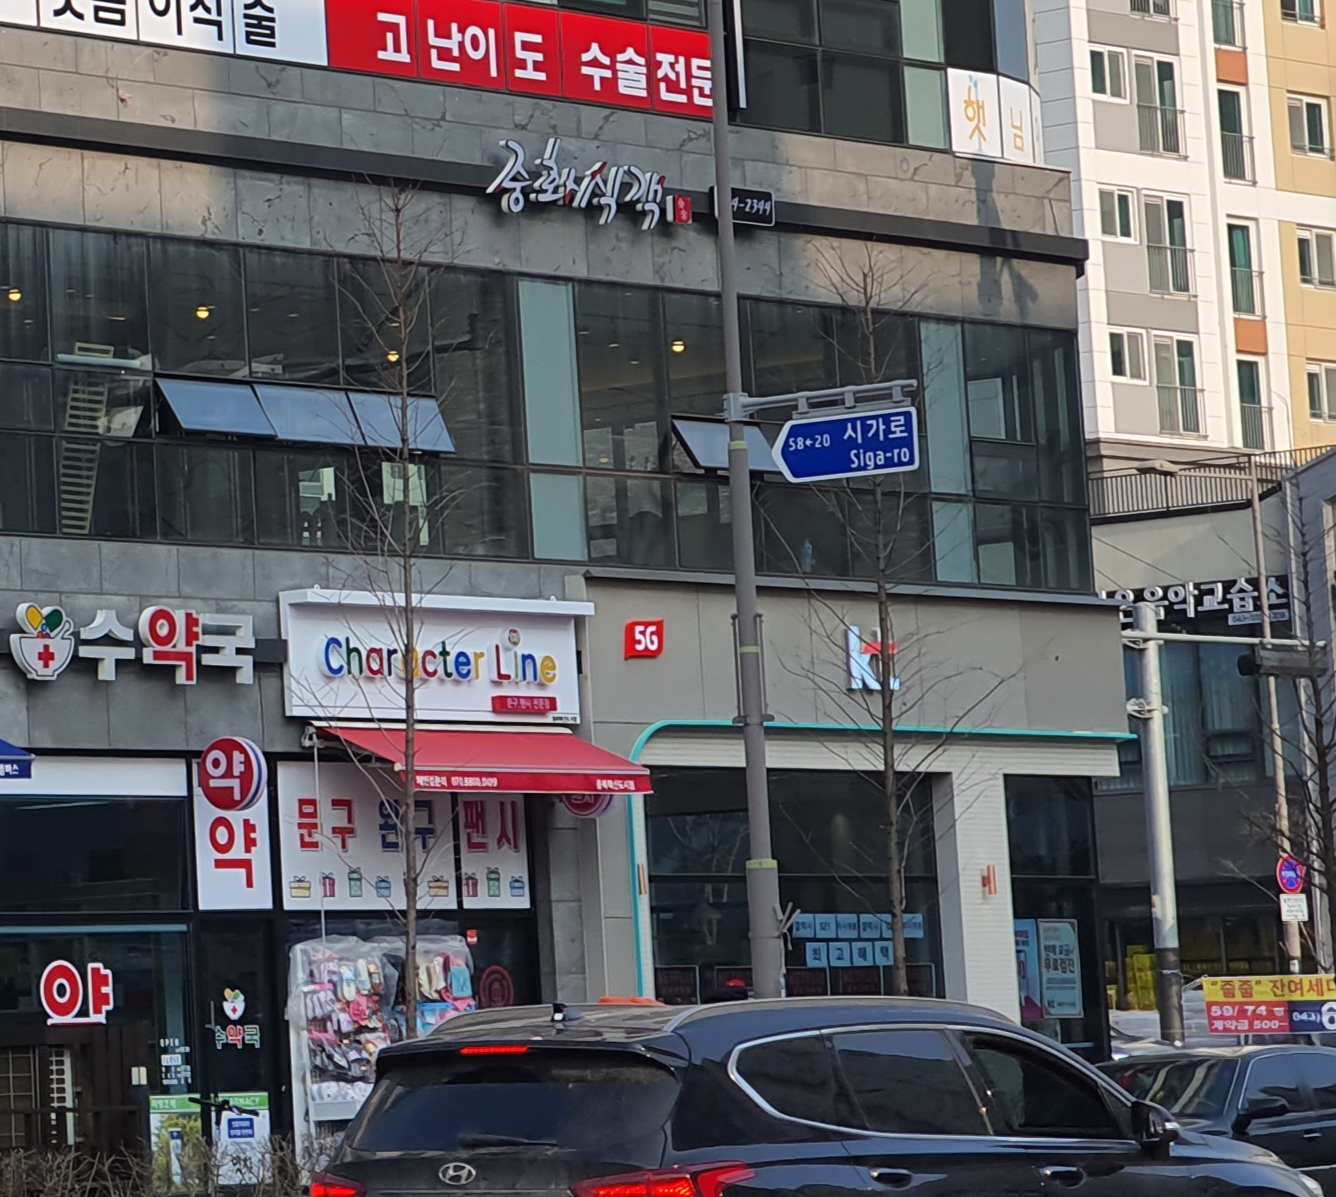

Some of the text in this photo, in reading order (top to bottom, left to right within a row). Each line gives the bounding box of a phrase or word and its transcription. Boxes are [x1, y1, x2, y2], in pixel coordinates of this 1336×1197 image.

[843, 415, 909, 444] 시가로
[850, 447, 910, 470] Siga-ro
[77, 604, 256, 685] 수약국
[634, 625, 659, 651] 5G
[494, 644, 558, 686] Line
[205, 746, 247, 800] 약
[297, 798, 356, 852] 문구
[209, 815, 258, 889] 약
[215, 1024, 261, 1050] 수약국
